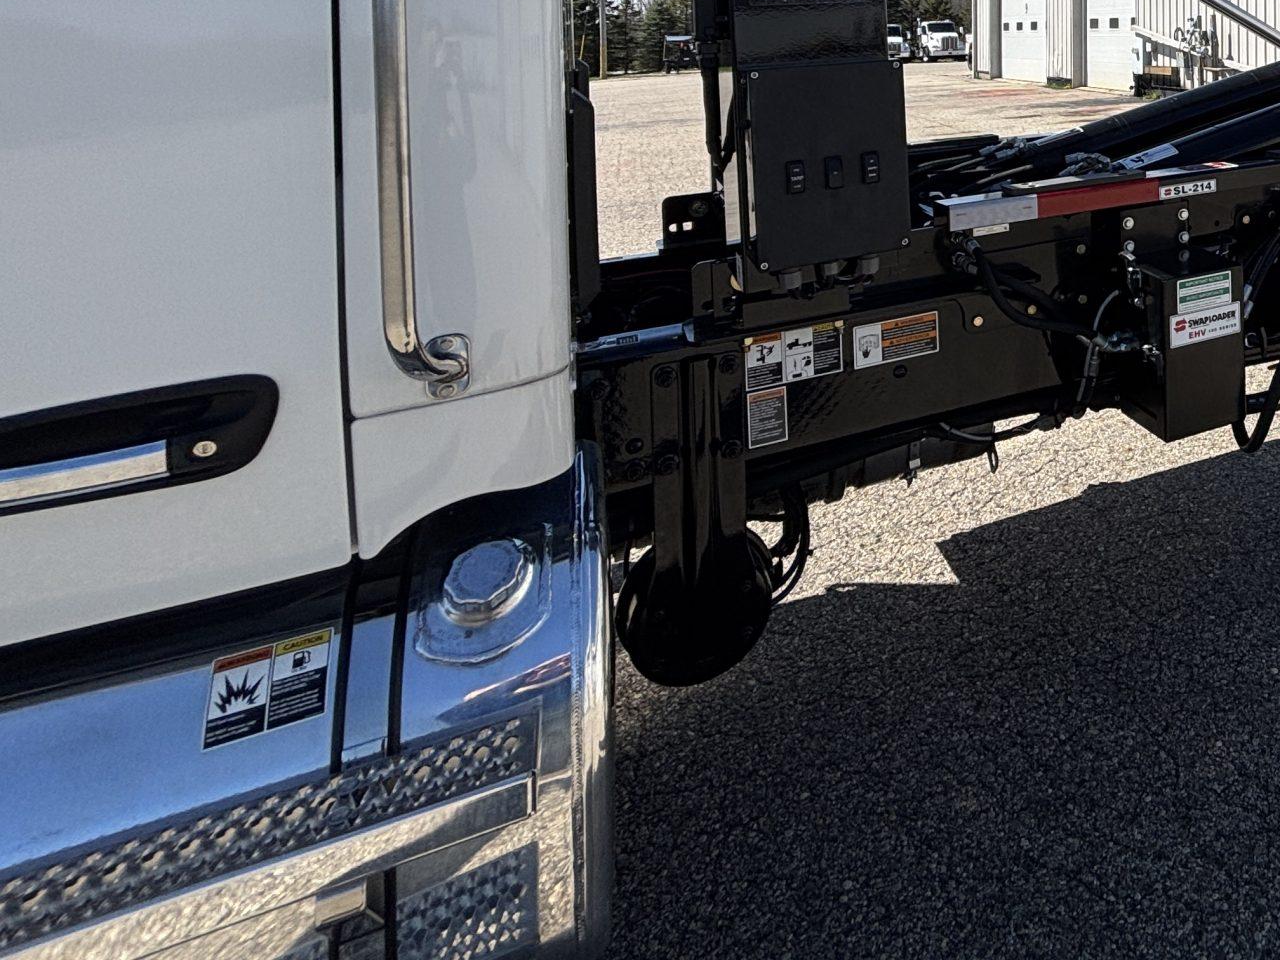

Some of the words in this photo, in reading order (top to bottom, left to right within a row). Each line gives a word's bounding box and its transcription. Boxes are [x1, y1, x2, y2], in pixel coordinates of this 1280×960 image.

[1173, 182, 1212, 196] SL-214
[1188, 311, 1236, 327] SWAPLOADER
[1188, 328, 1207, 339] EHV
[283, 635, 324, 651] CAUTION
